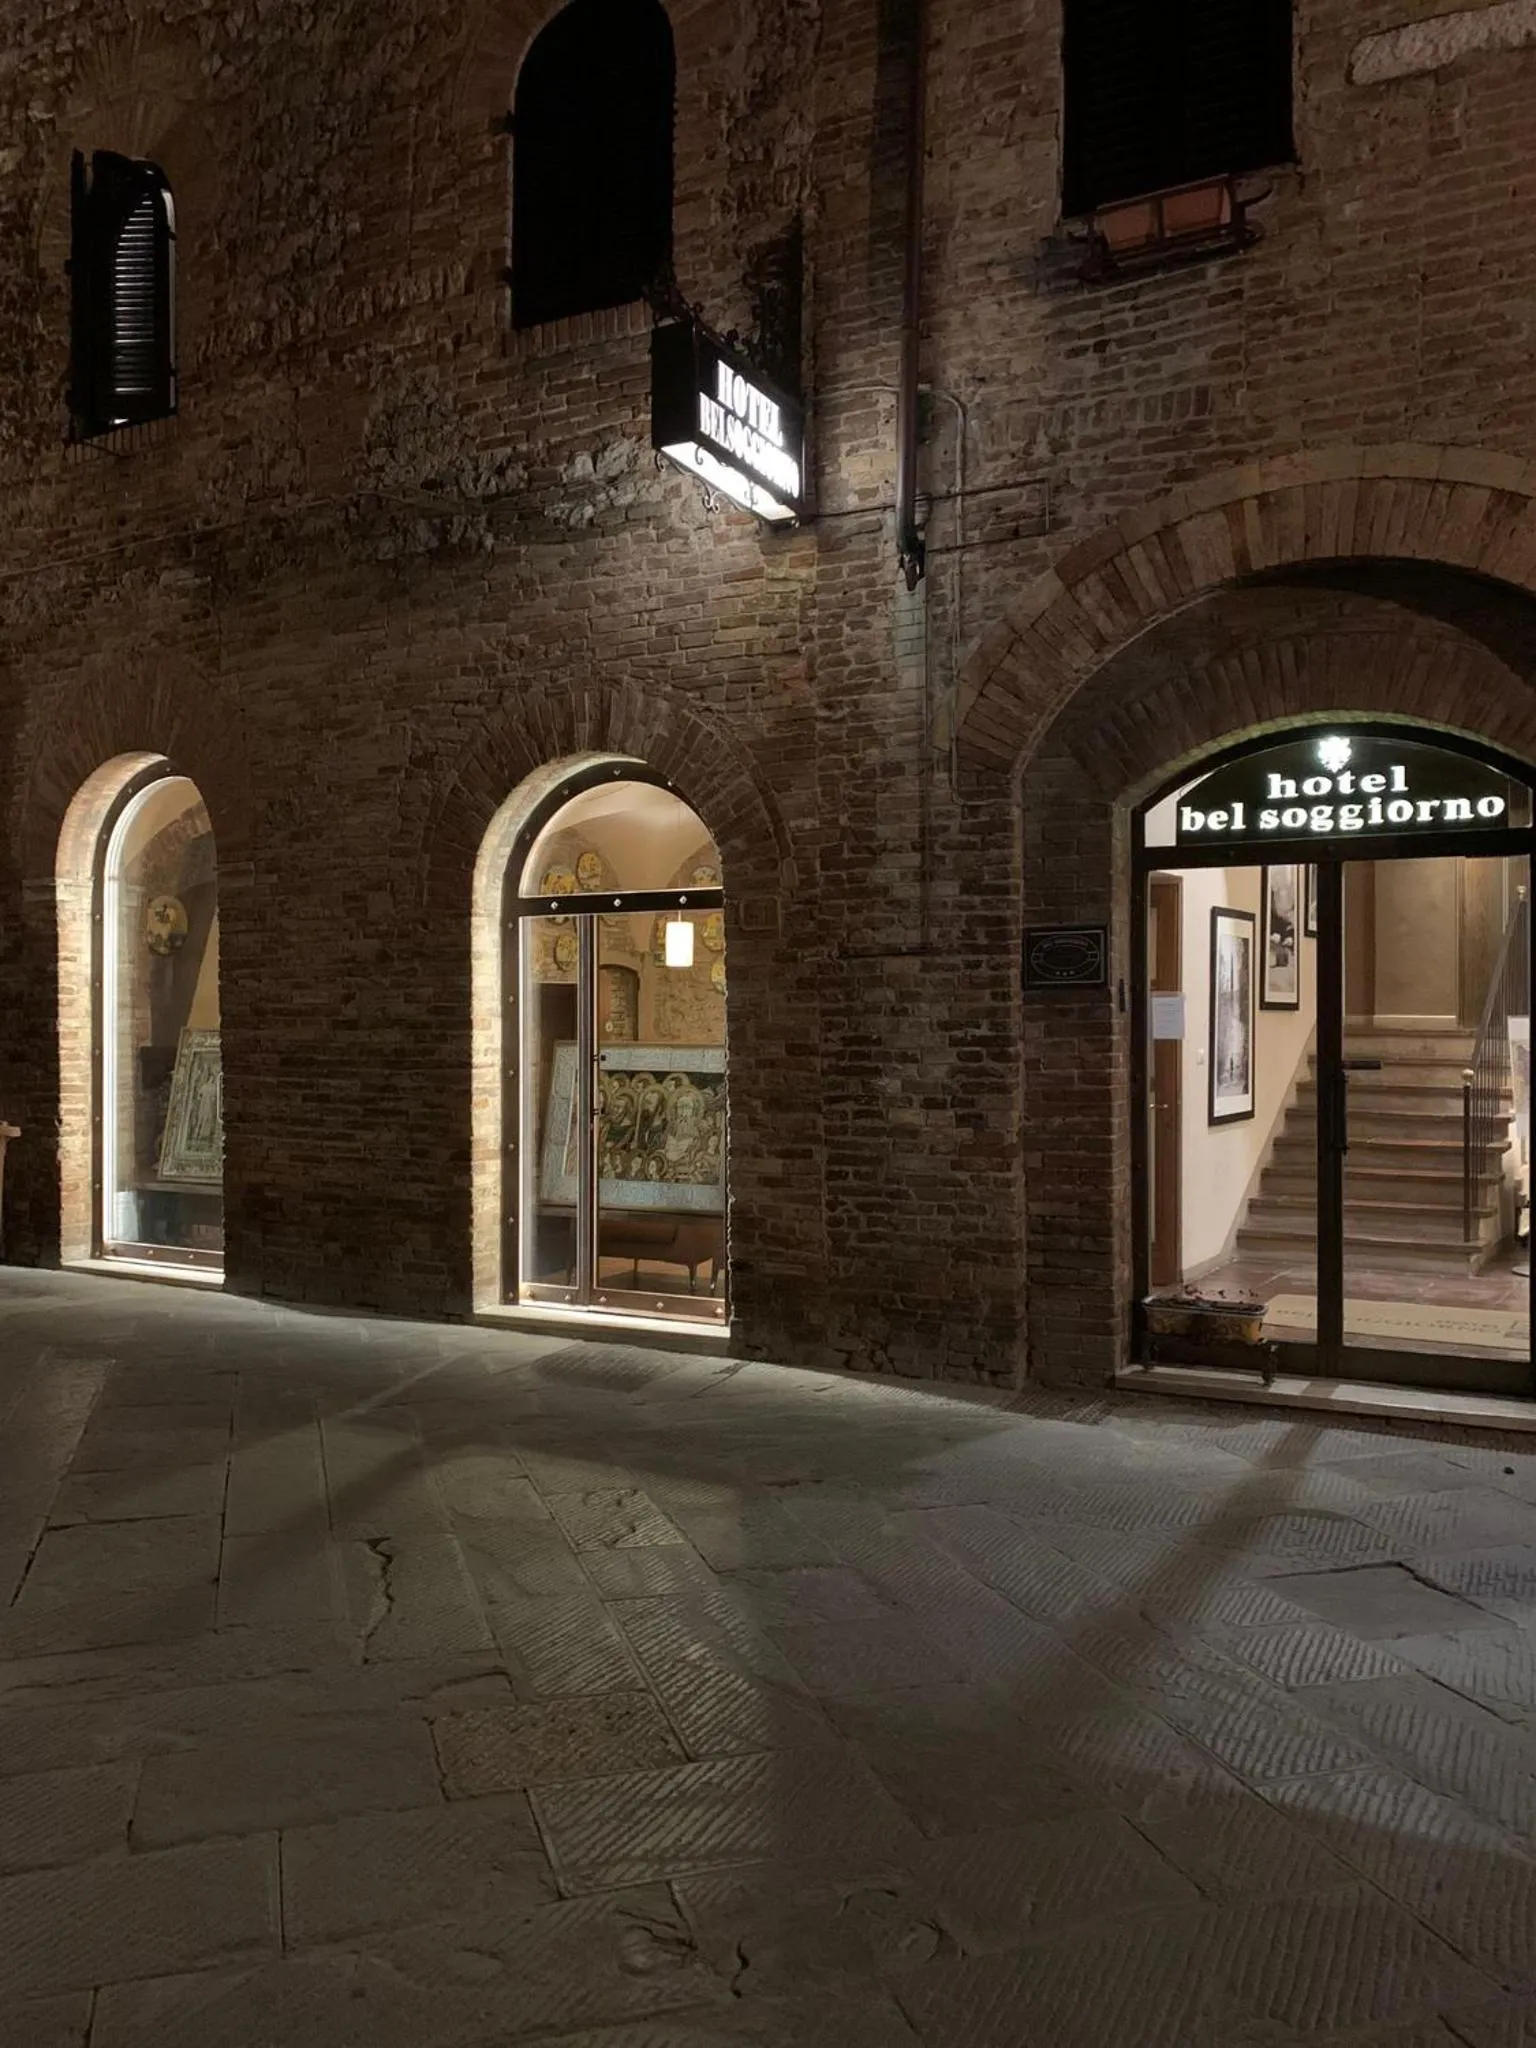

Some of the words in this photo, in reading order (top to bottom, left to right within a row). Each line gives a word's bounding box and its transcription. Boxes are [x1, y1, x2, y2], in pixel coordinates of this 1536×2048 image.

[700, 392, 729, 450] BEL
[718, 360, 783, 448] HOTEL
[1267, 765, 1409, 800] hotel
[1181, 803, 1246, 832] bel
[1259, 796, 1506, 832] soggiorno
